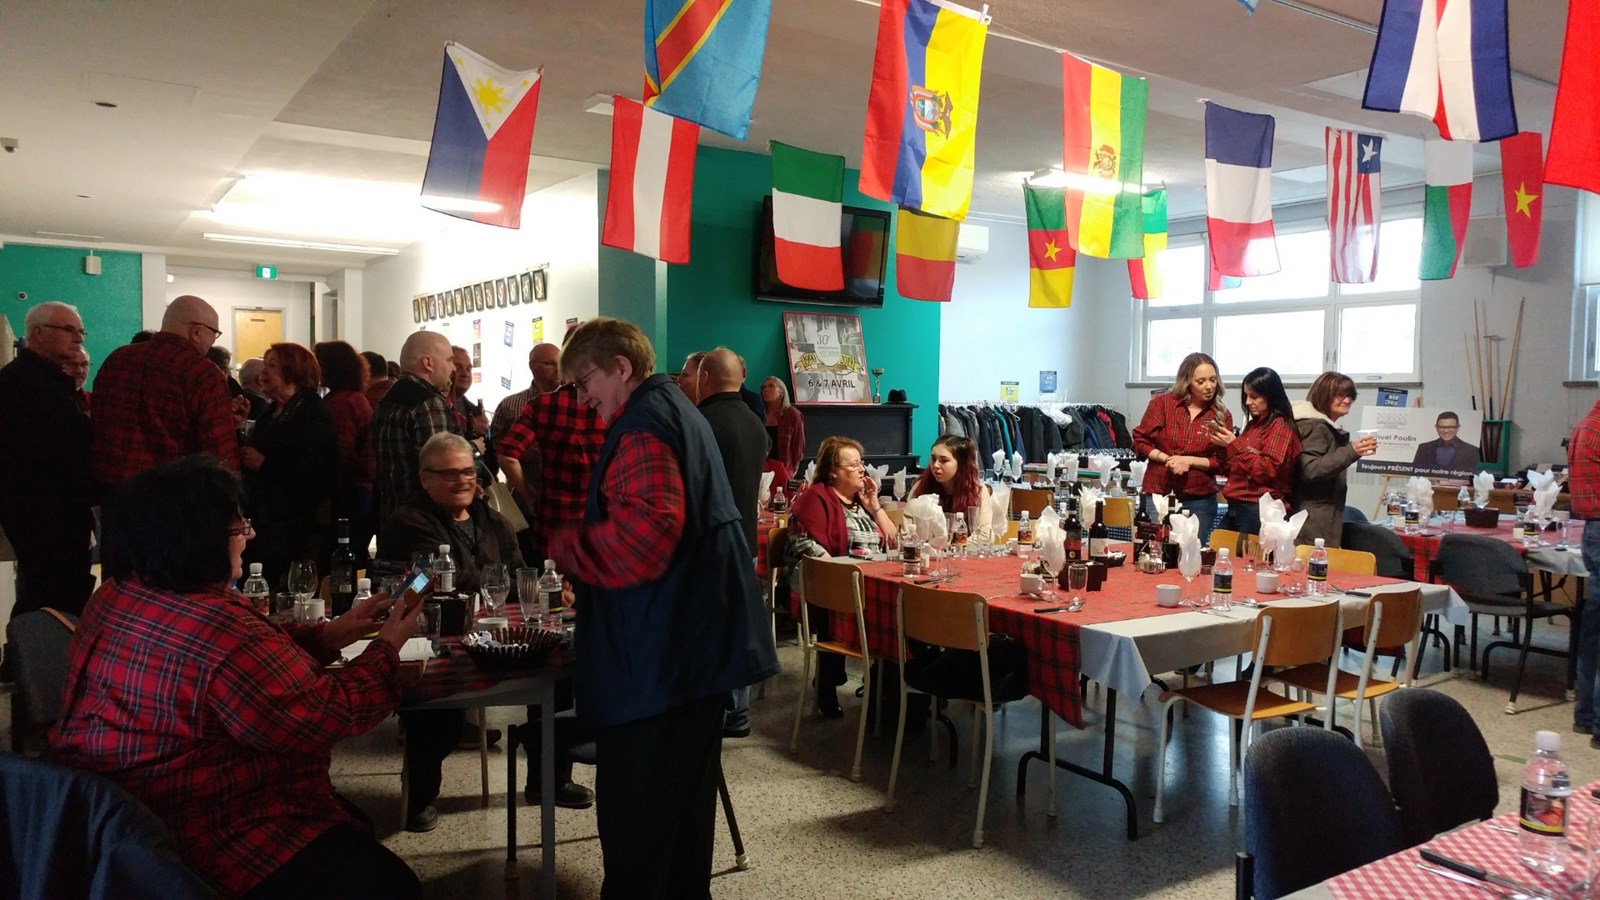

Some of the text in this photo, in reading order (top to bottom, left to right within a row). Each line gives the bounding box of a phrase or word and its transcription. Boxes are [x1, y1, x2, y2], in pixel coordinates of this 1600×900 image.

[815, 379, 822, 387] &
[823, 379, 829, 387] 7
[831, 379, 856, 388] AVRIL
[1387, 464, 1414, 472] PRÉSENT
